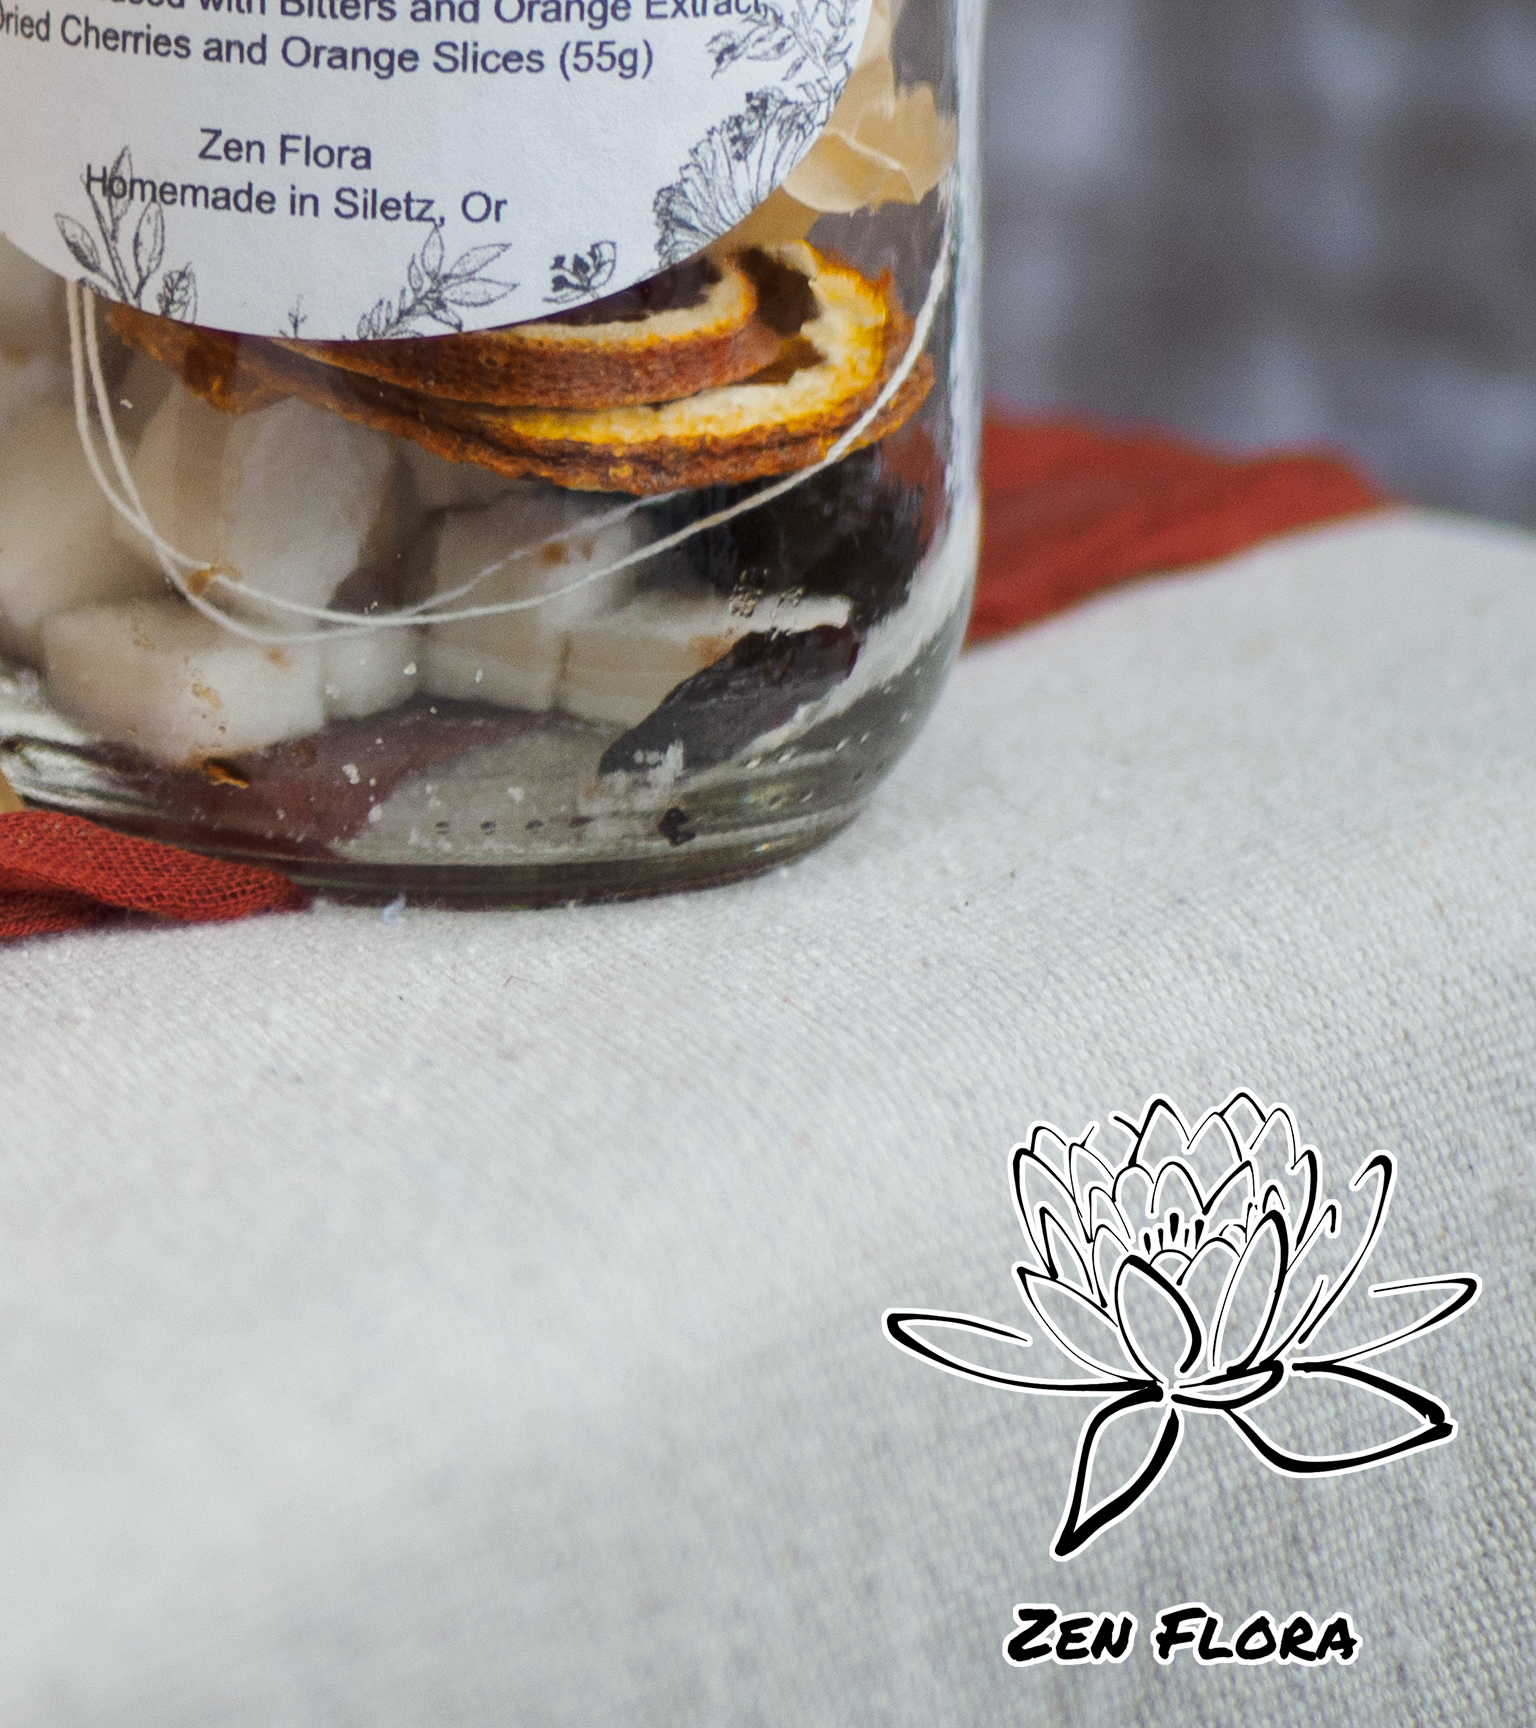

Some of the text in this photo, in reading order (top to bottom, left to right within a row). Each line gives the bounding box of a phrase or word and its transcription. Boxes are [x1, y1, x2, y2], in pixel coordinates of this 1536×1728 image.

[60, 13, 192, 60] Cherries
[202, 34, 268, 67] and
[280, 35, 420, 80] Orange
[432, 39, 545, 74] Slices
[558, 38, 654, 82] (55g)
[198, 127, 373, 171] Zen Flora
[85, 164, 508, 227] Homemade in Siletz, Or
